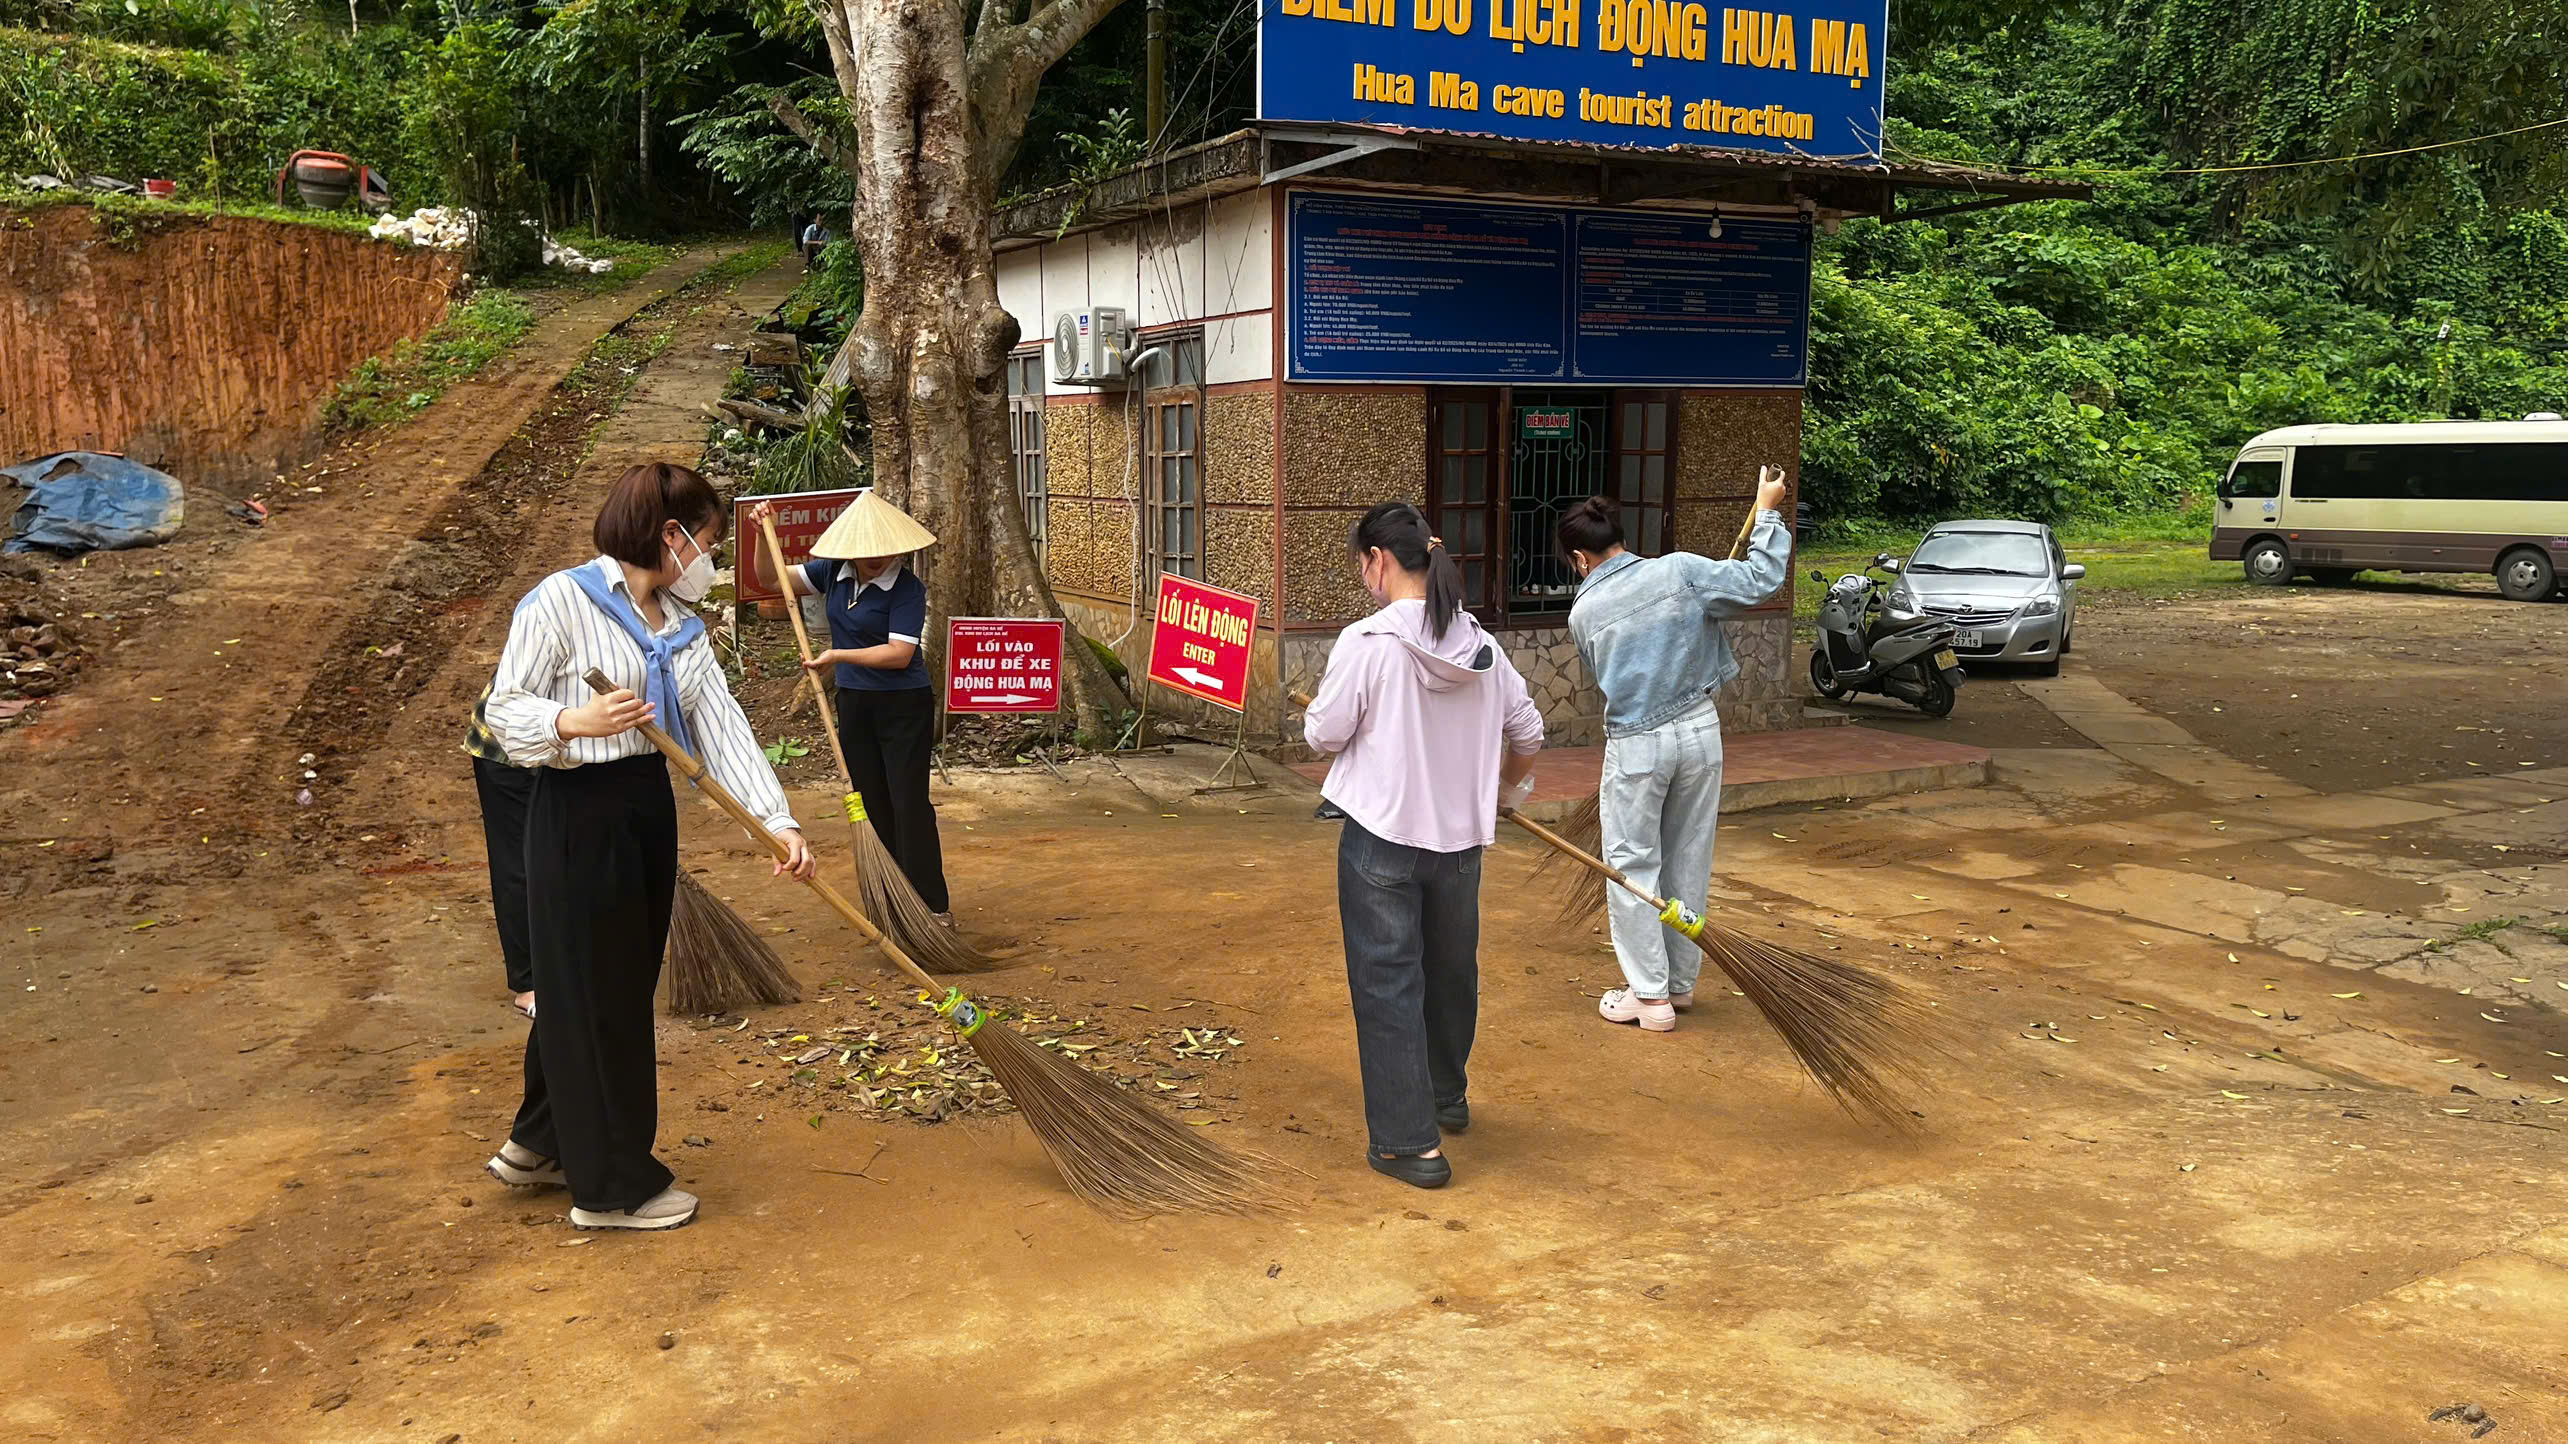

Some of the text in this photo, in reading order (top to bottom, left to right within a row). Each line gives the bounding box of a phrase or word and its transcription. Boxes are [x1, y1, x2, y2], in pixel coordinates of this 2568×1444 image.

[1489, 0, 1581, 53] LỊCH
[1722, 7, 1797, 71] HUA
[1810, 18, 1870, 89] MẠ
[1353, 62, 1814, 140] Hua Ma cave tourist attraction
[776, 505, 810, 526] IỂM
[1161, 589, 1249, 648] LỐI LÊN ĐỘNG
[977, 639, 1034, 652] LỐI VÀO
[1183, 641, 1216, 666] ENTER
[960, 658, 995, 670] KHU
[1029, 658, 1051, 670] XE
[954, 674, 1053, 692] ĐỘNG HUA MẠ
